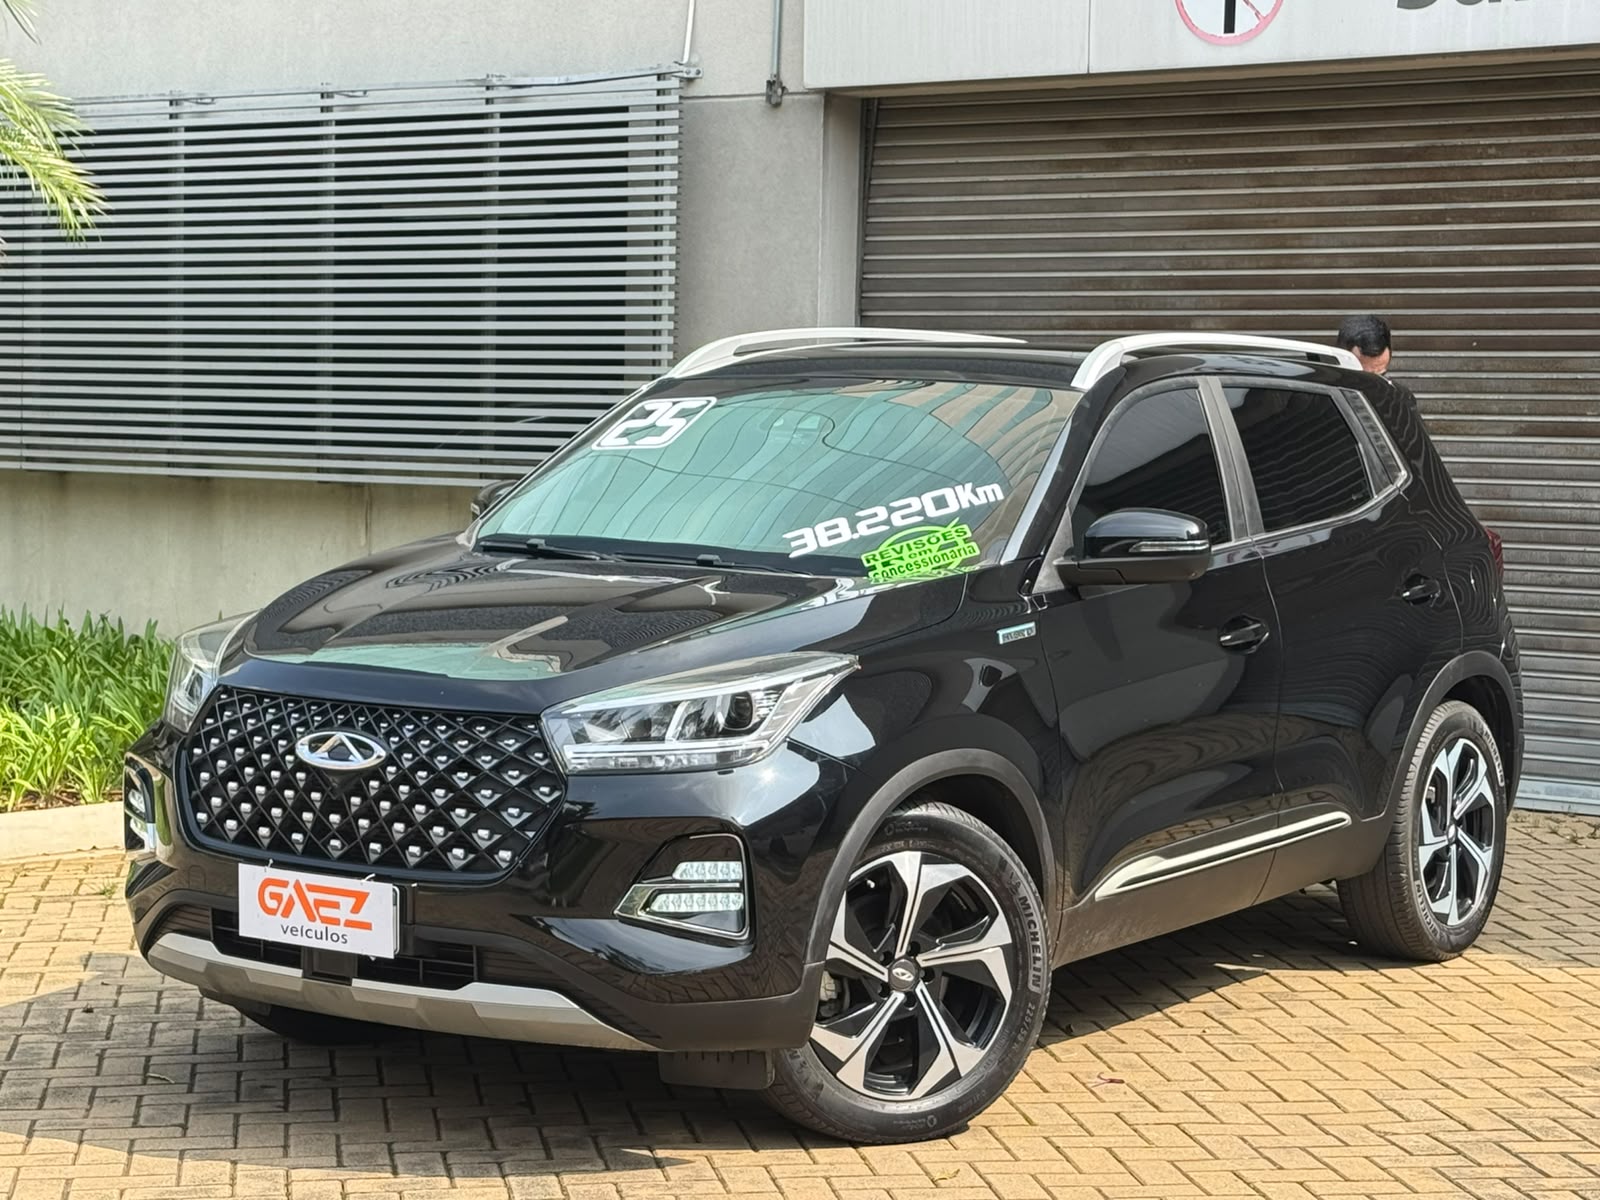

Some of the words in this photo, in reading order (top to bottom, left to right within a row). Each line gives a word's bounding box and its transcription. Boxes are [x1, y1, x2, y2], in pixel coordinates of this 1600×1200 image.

[600, 400, 709, 446] 25
[908, 548, 933, 559] em
[258, 878, 373, 931] GAEZ
[281, 924, 348, 944] veículos
[1018, 895, 1042, 988] MICHELIN
